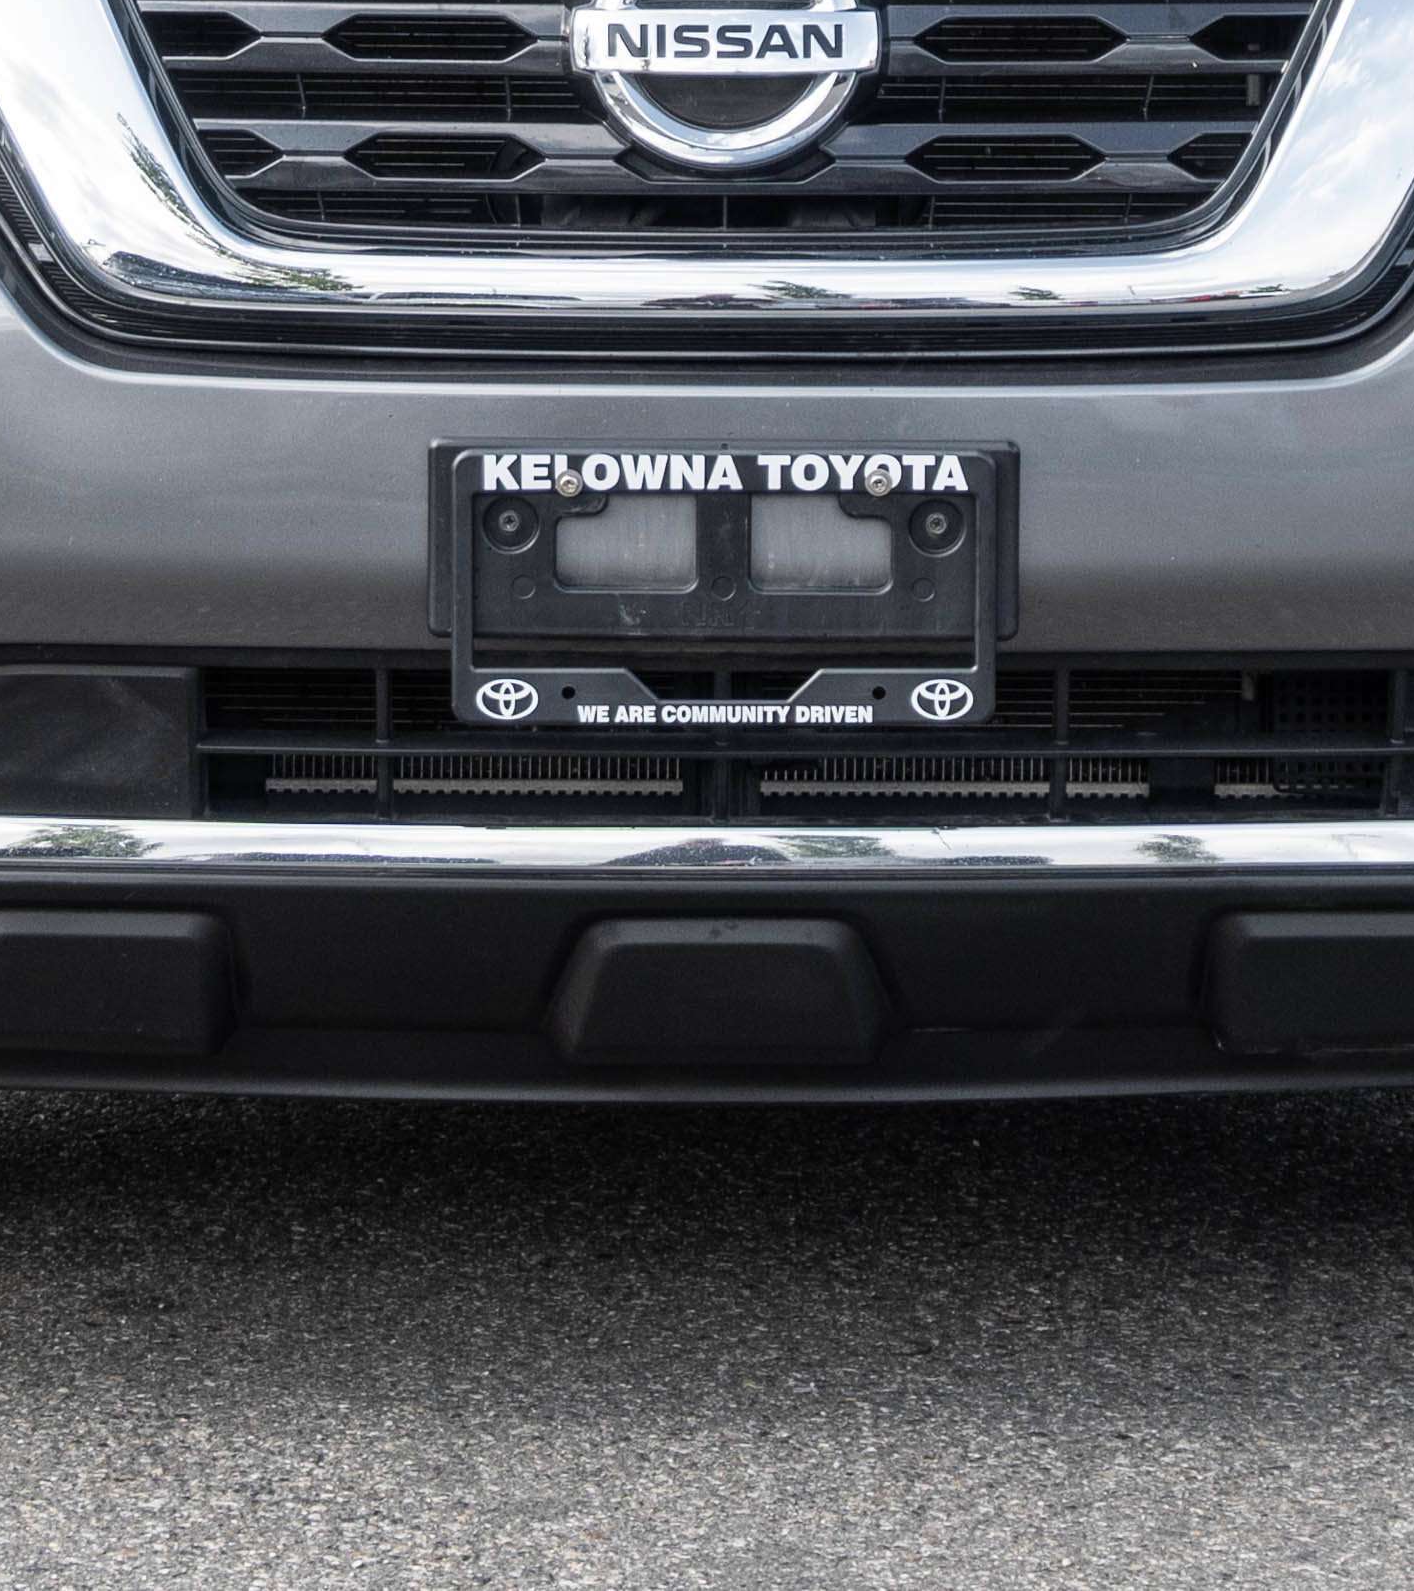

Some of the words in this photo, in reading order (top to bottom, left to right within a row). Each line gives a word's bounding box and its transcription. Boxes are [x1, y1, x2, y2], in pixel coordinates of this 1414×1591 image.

[607, 23, 843, 59] NISSAN
[757, 453, 969, 491] TOYOTA
[577, 704, 610, 723] WE
[614, 704, 657, 723] ARE
[661, 704, 791, 724] COMMUNITY
[795, 704, 873, 723] DRIVEN
